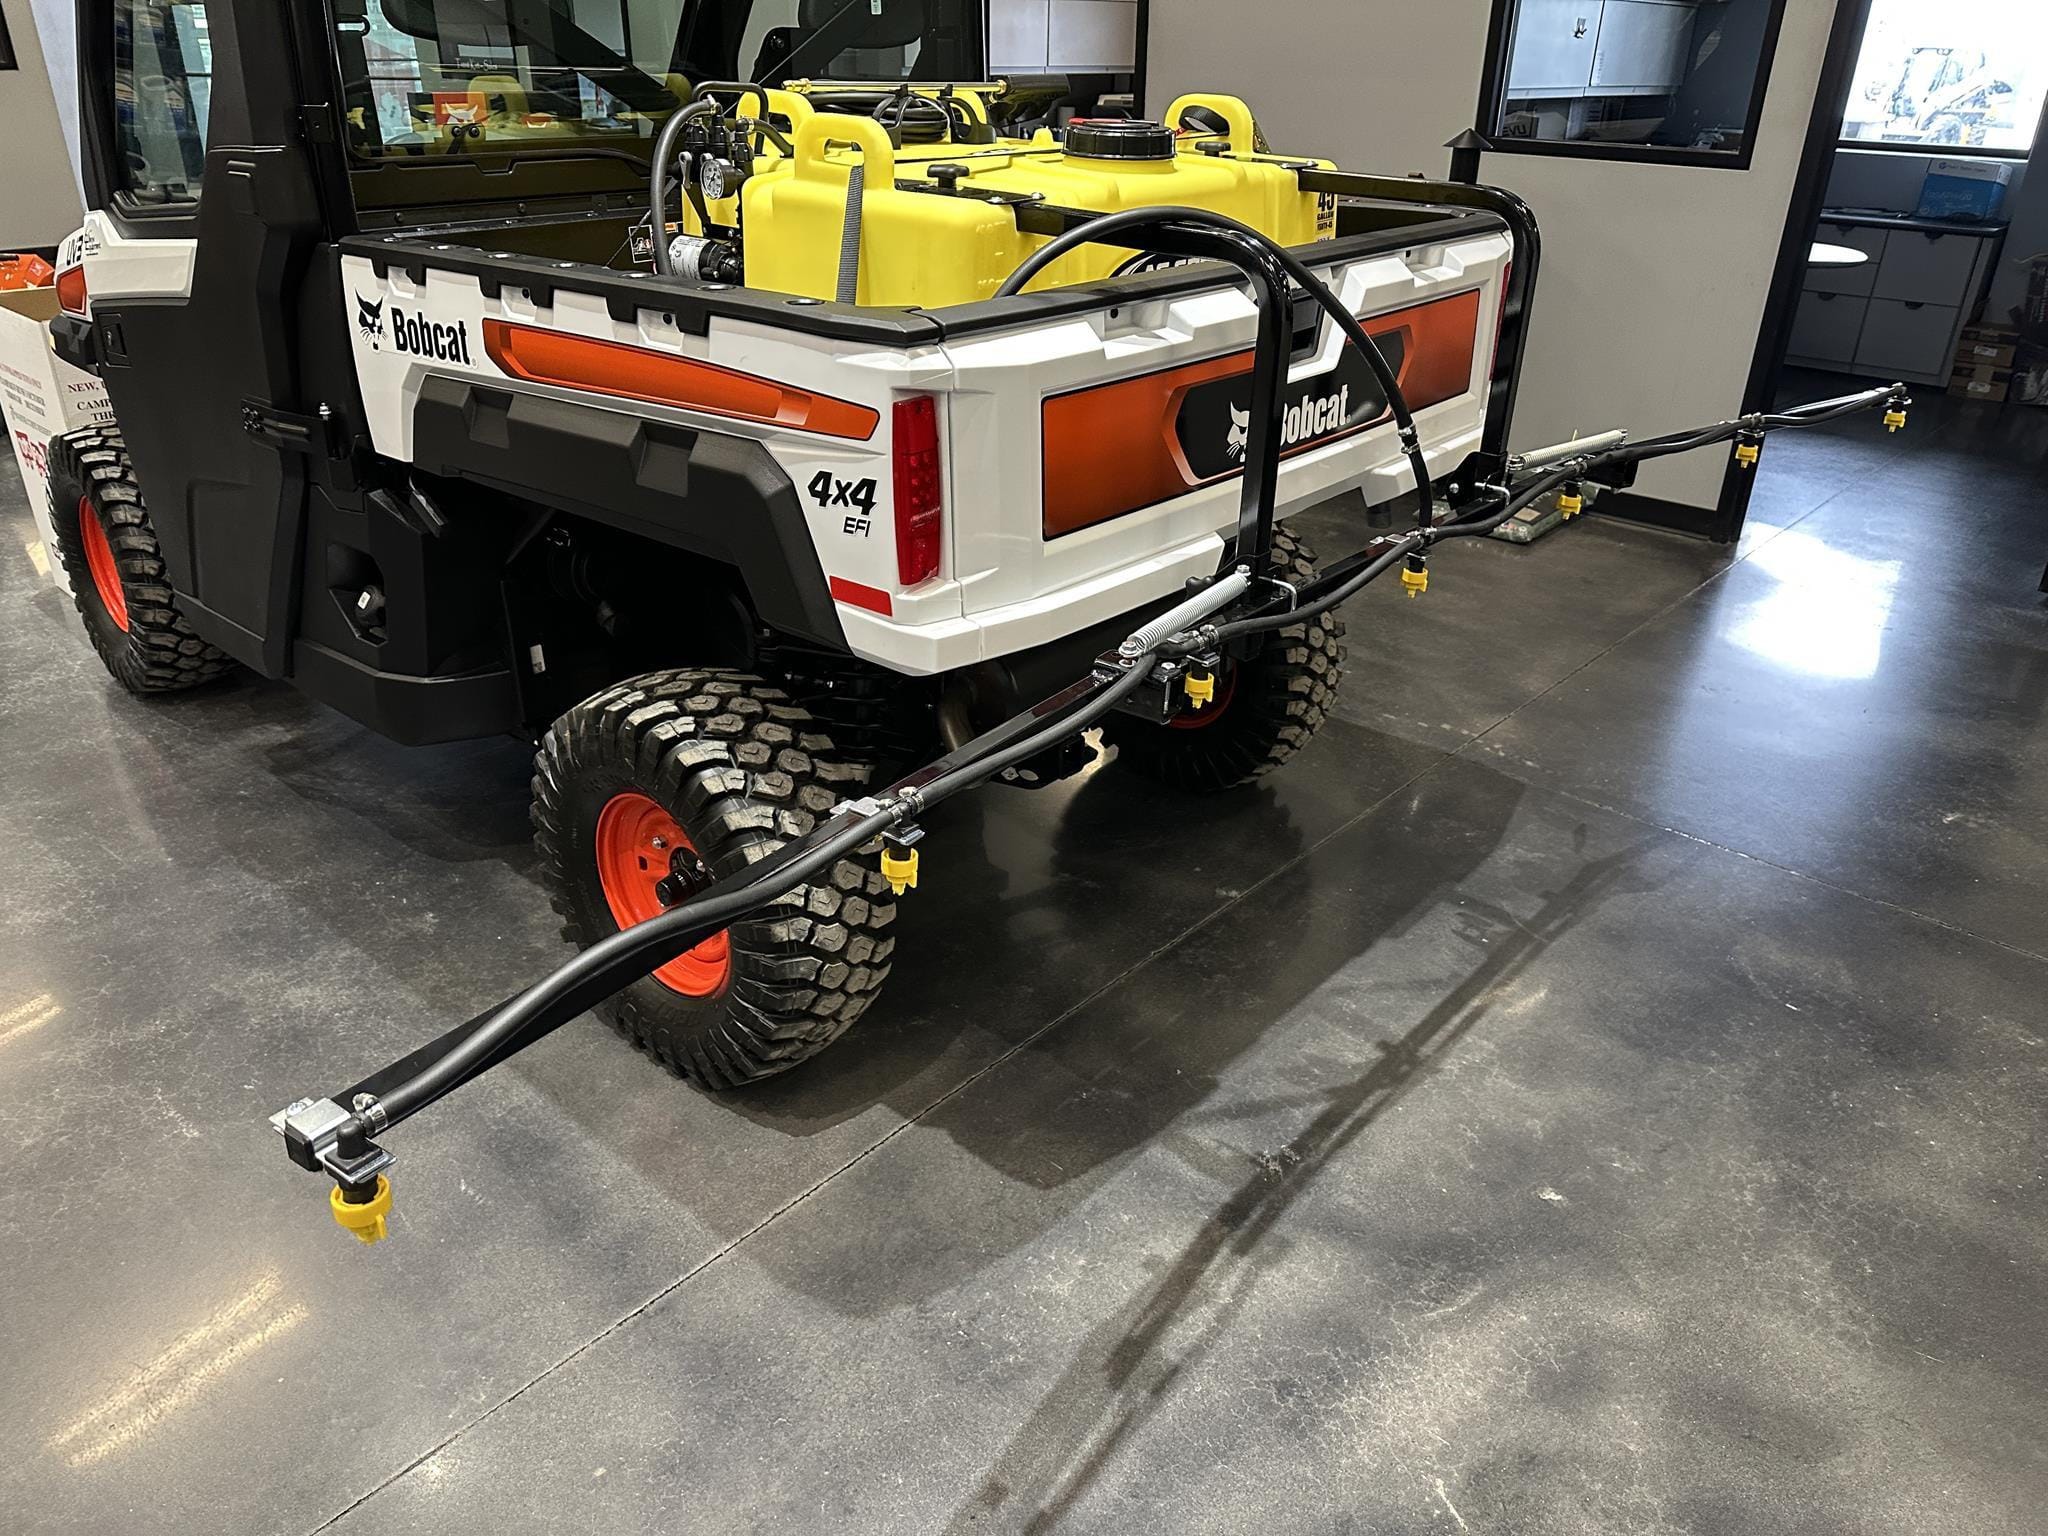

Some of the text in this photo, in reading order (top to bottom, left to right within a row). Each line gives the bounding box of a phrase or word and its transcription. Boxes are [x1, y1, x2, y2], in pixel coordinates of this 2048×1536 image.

[391, 306, 471, 366] Bobcat
[67, 381, 100, 393] NEW,
[807, 470, 878, 516] 4x4
[843, 516, 871, 538] EFI
